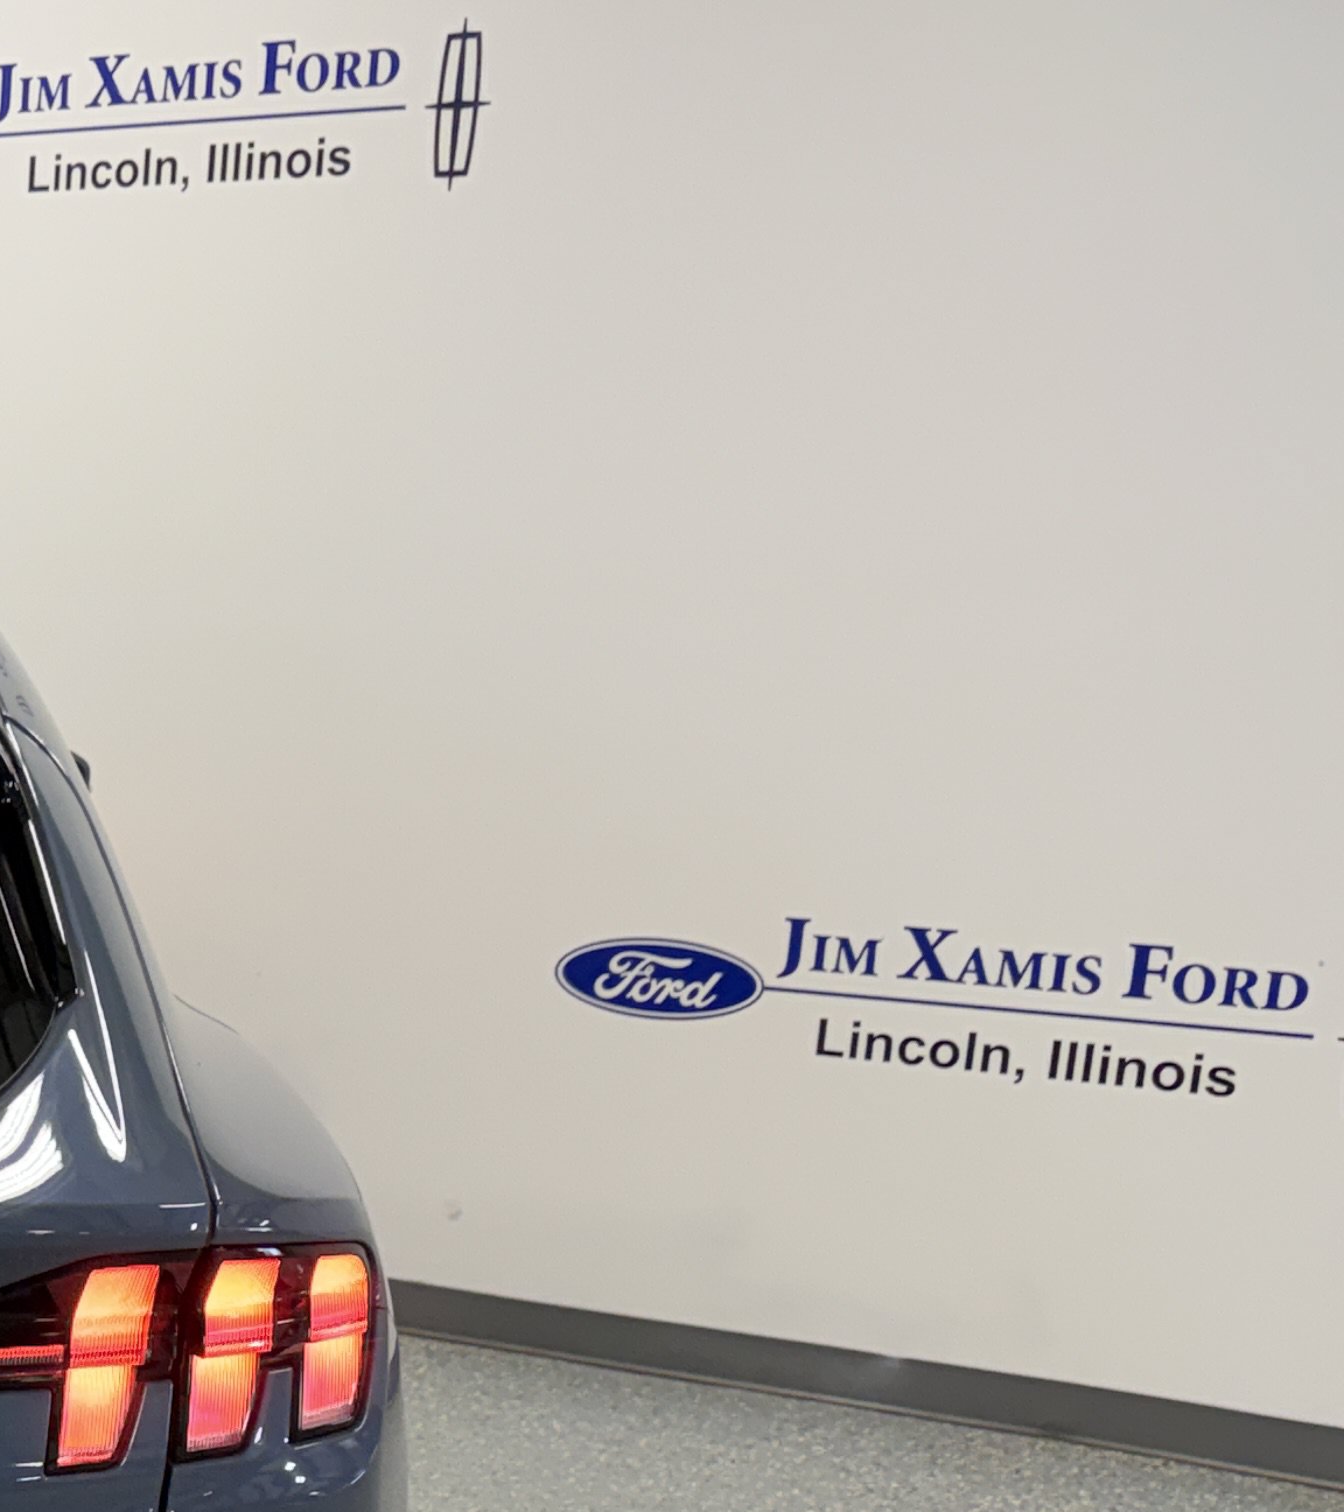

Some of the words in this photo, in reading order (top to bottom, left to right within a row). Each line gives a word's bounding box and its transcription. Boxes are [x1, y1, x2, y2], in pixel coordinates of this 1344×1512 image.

[85, 53, 242, 109] XAMIS
[258, 39, 401, 96] FORD
[27, 148, 191, 193] Lincoln,
[207, 137, 352, 183] Illinois
[592, 950, 719, 1010] Ford
[776, 916, 884, 980] JIM
[897, 925, 1102, 996] XAMIS
[1121, 943, 1310, 1012] FORD
[815, 1018, 1027, 1083] Lincoln,
[1047, 1039, 1238, 1098] Illinois
